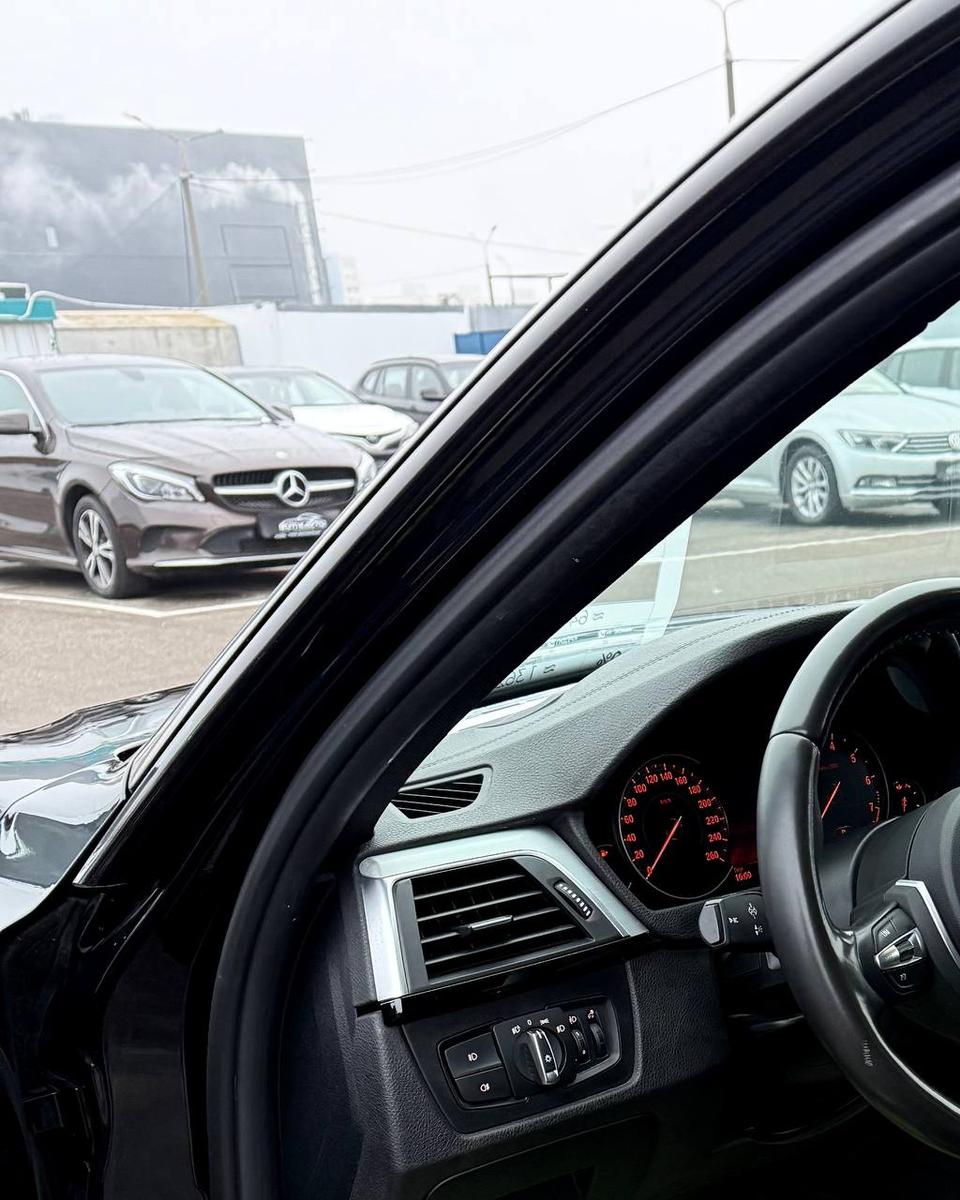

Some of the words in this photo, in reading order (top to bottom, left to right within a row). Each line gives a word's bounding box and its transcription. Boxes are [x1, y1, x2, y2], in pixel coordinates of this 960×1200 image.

[829, 741, 836, 751] 4
[850, 753, 857, 763] 5
[645, 773, 658, 785] 120
[660, 771, 673, 781] 140
[674, 775, 688, 786] 160
[865, 775, 872, 785] 6
[633, 783, 647, 794] 100
[688, 784, 701, 795] 180
[626, 797, 637, 807] 80
[697, 798, 712, 809] 200
[868, 802, 874, 812] 7
[623, 814, 634, 824] 60
[705, 815, 720, 825] 220
[626, 833, 637, 842] 40
[707, 831, 722, 842] 240
[633, 849, 645, 860] 20
[705, 850, 720, 861] 260
